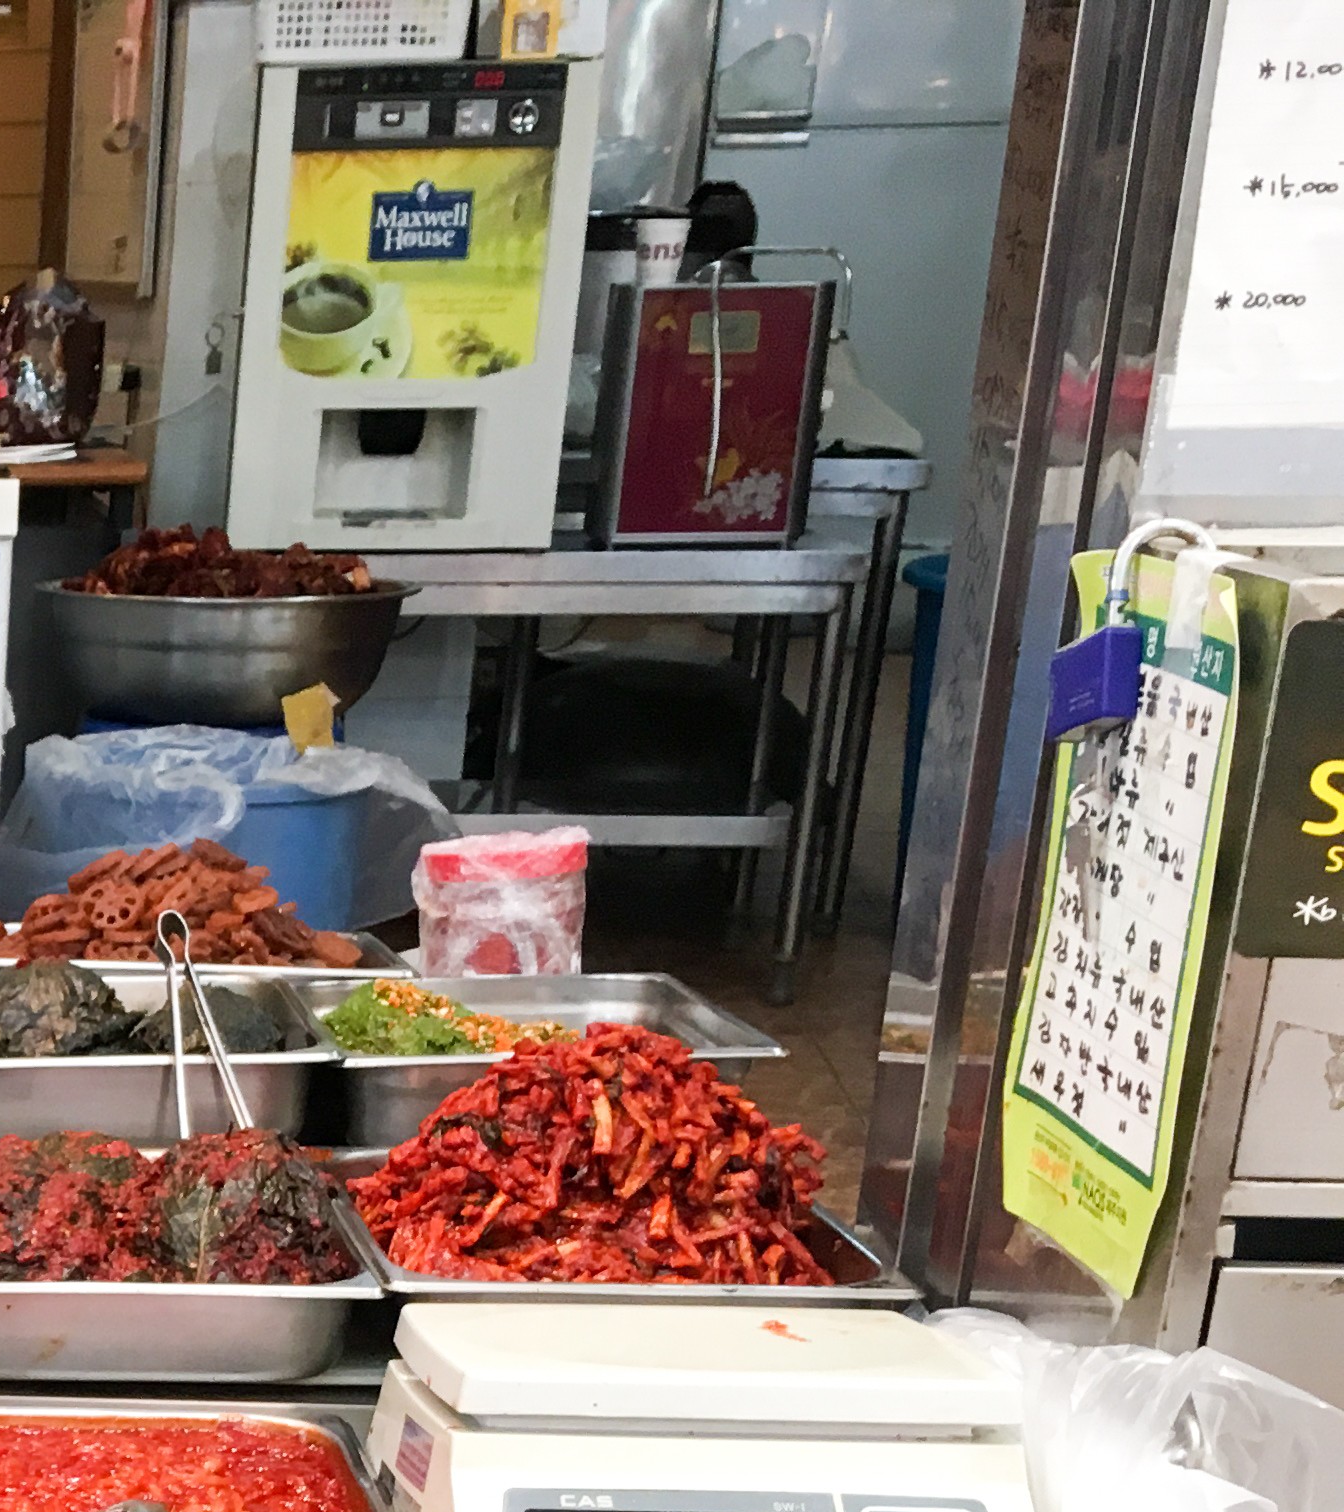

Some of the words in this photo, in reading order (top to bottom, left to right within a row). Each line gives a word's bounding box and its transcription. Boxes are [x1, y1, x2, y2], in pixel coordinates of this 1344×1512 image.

[374, 202, 469, 229] Maxwell
[383, 228, 456, 252] House
[559, 1494, 614, 1509] CAS
